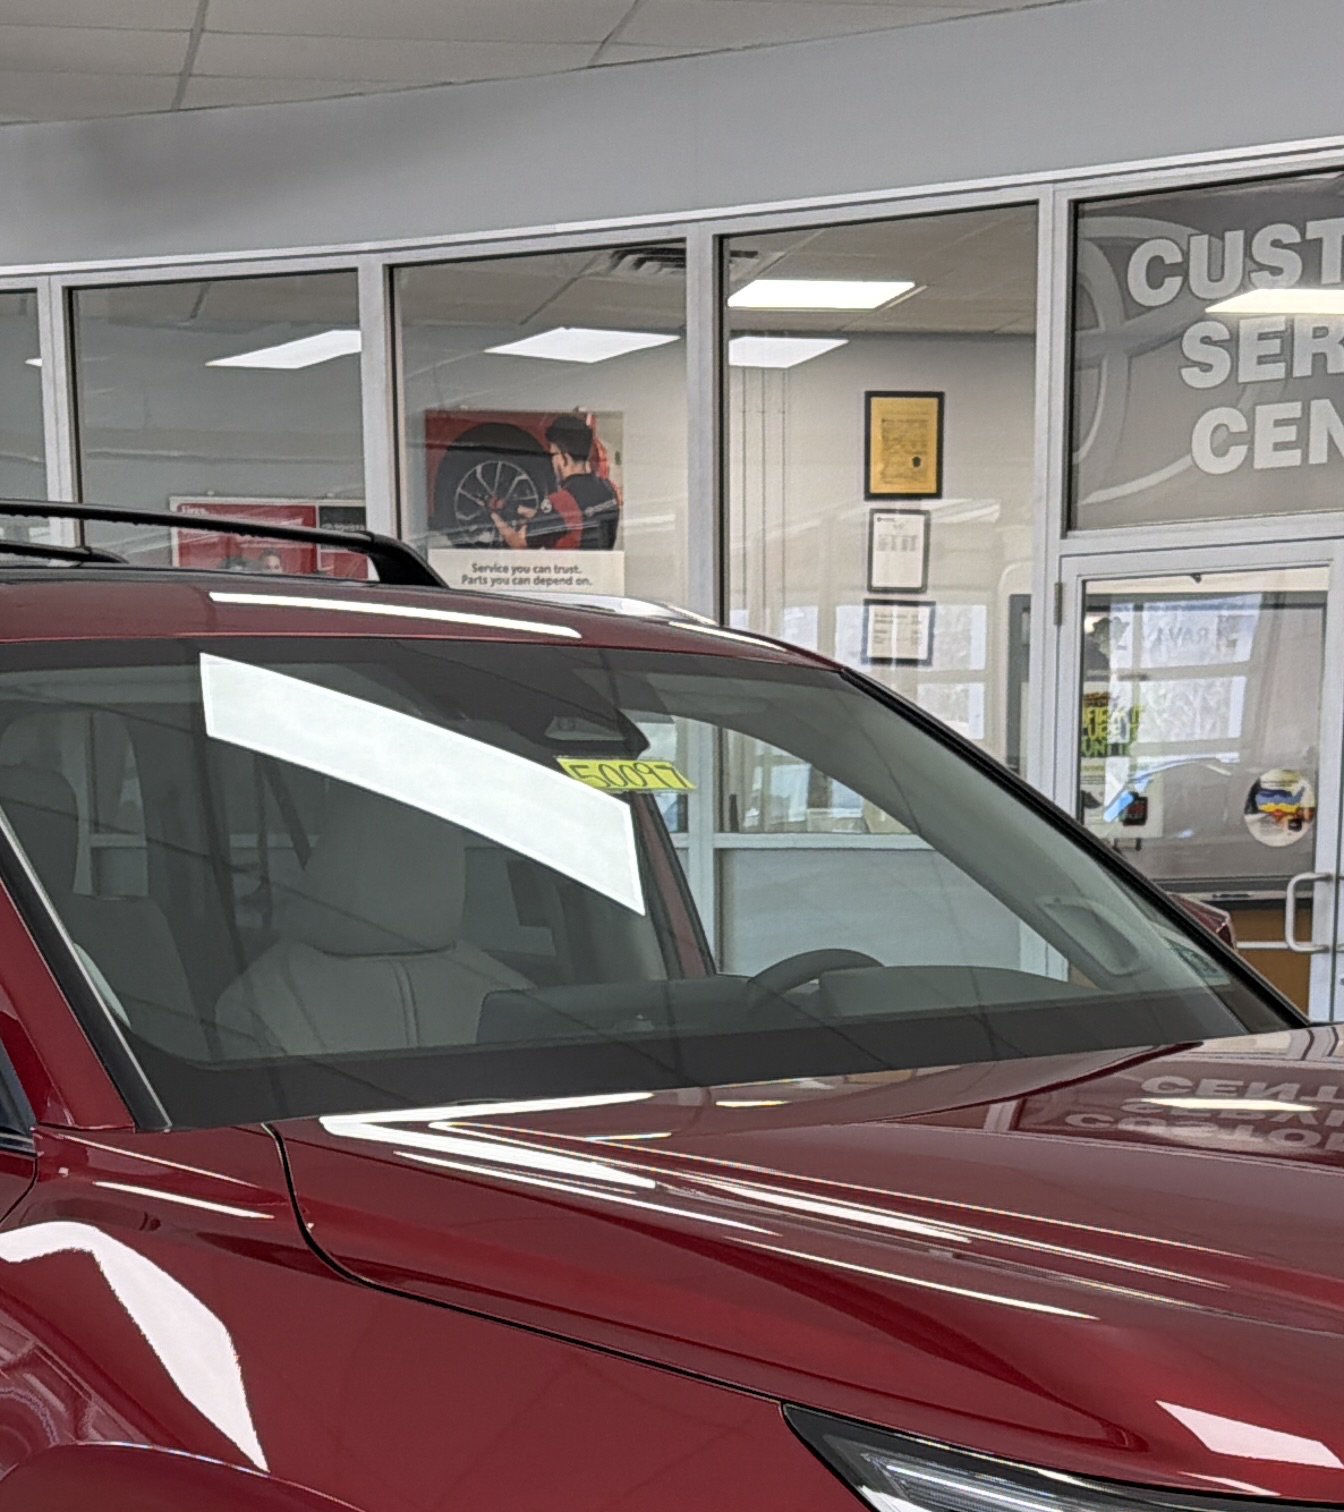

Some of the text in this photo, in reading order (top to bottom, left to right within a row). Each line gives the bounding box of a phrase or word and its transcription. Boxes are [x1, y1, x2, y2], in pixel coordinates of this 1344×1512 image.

[471, 562, 582, 577] Service you can trust.
[460, 574, 593, 588] Parts you can depend on.
[569, 762, 688, 788] 50097
